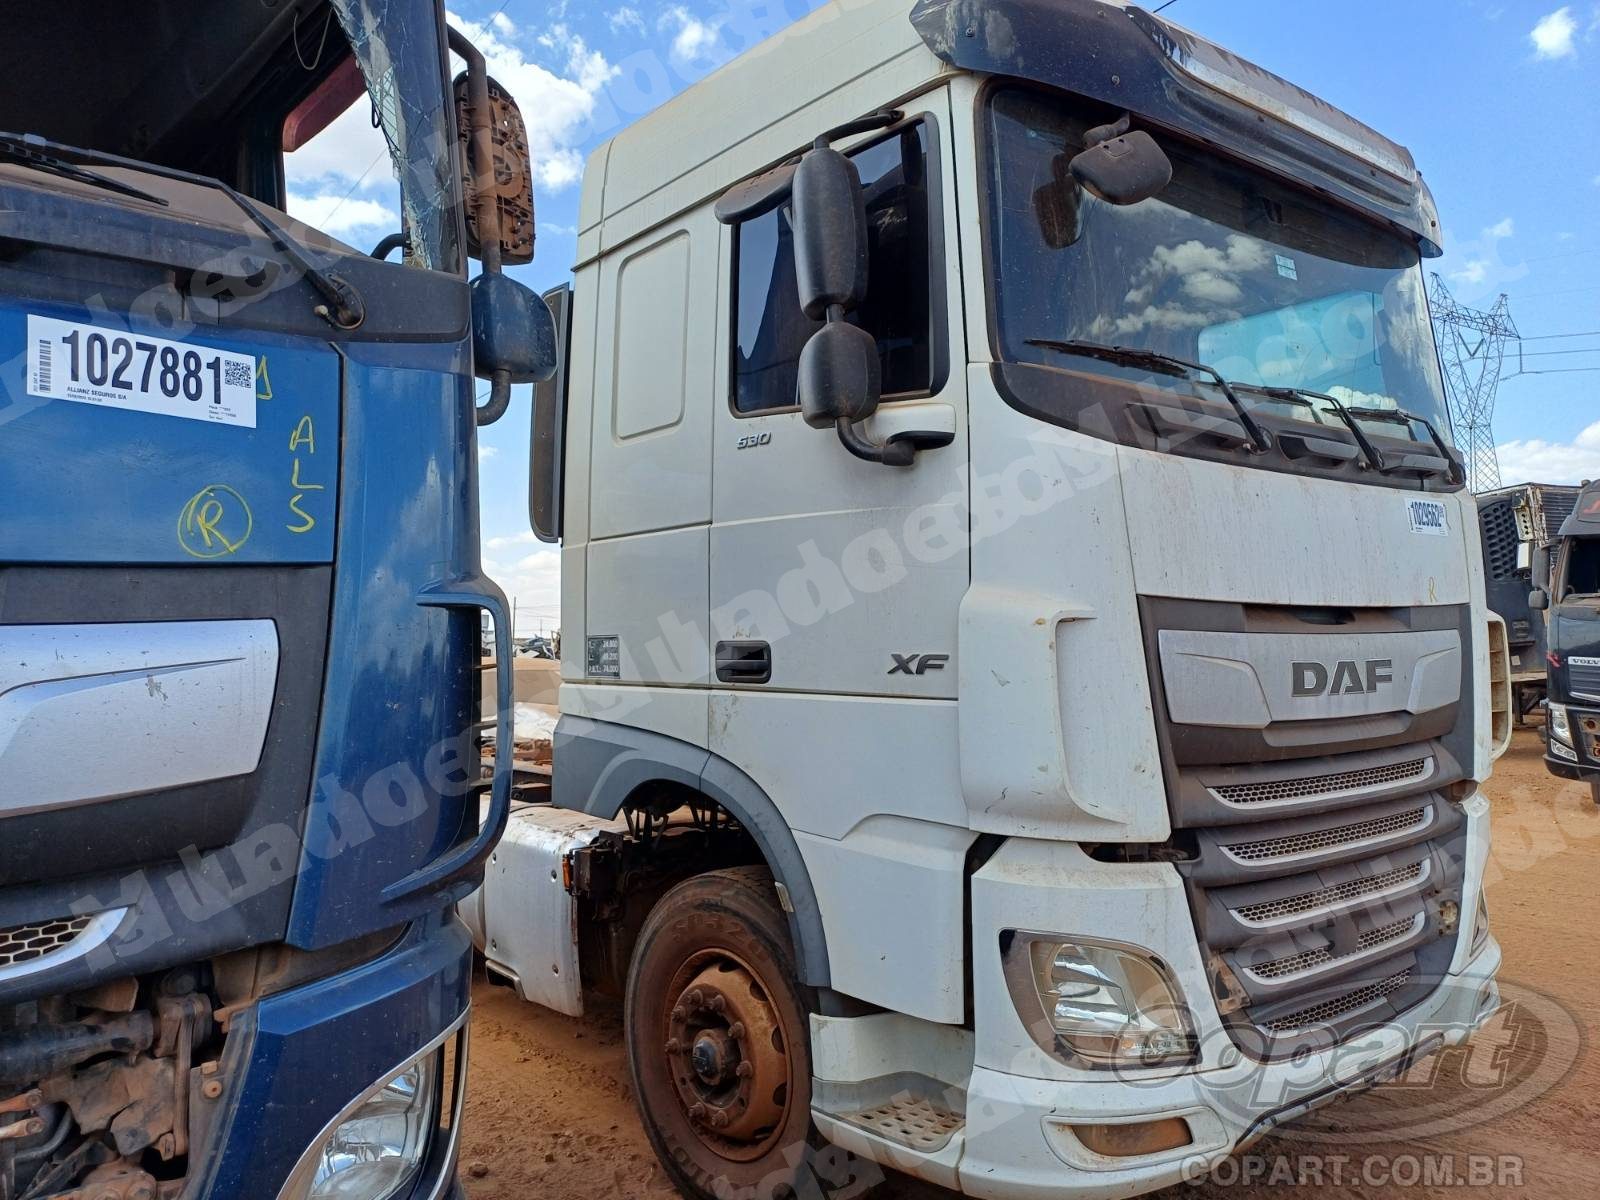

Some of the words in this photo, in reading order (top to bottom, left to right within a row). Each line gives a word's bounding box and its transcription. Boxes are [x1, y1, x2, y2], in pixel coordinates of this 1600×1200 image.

[62, 329, 222, 405] 1027881
[67, 386, 90, 395] ALLIANZ
[737, 431, 772, 450] 530
[887, 653, 950, 675] XF
[1291, 659, 1393, 697] DAF
